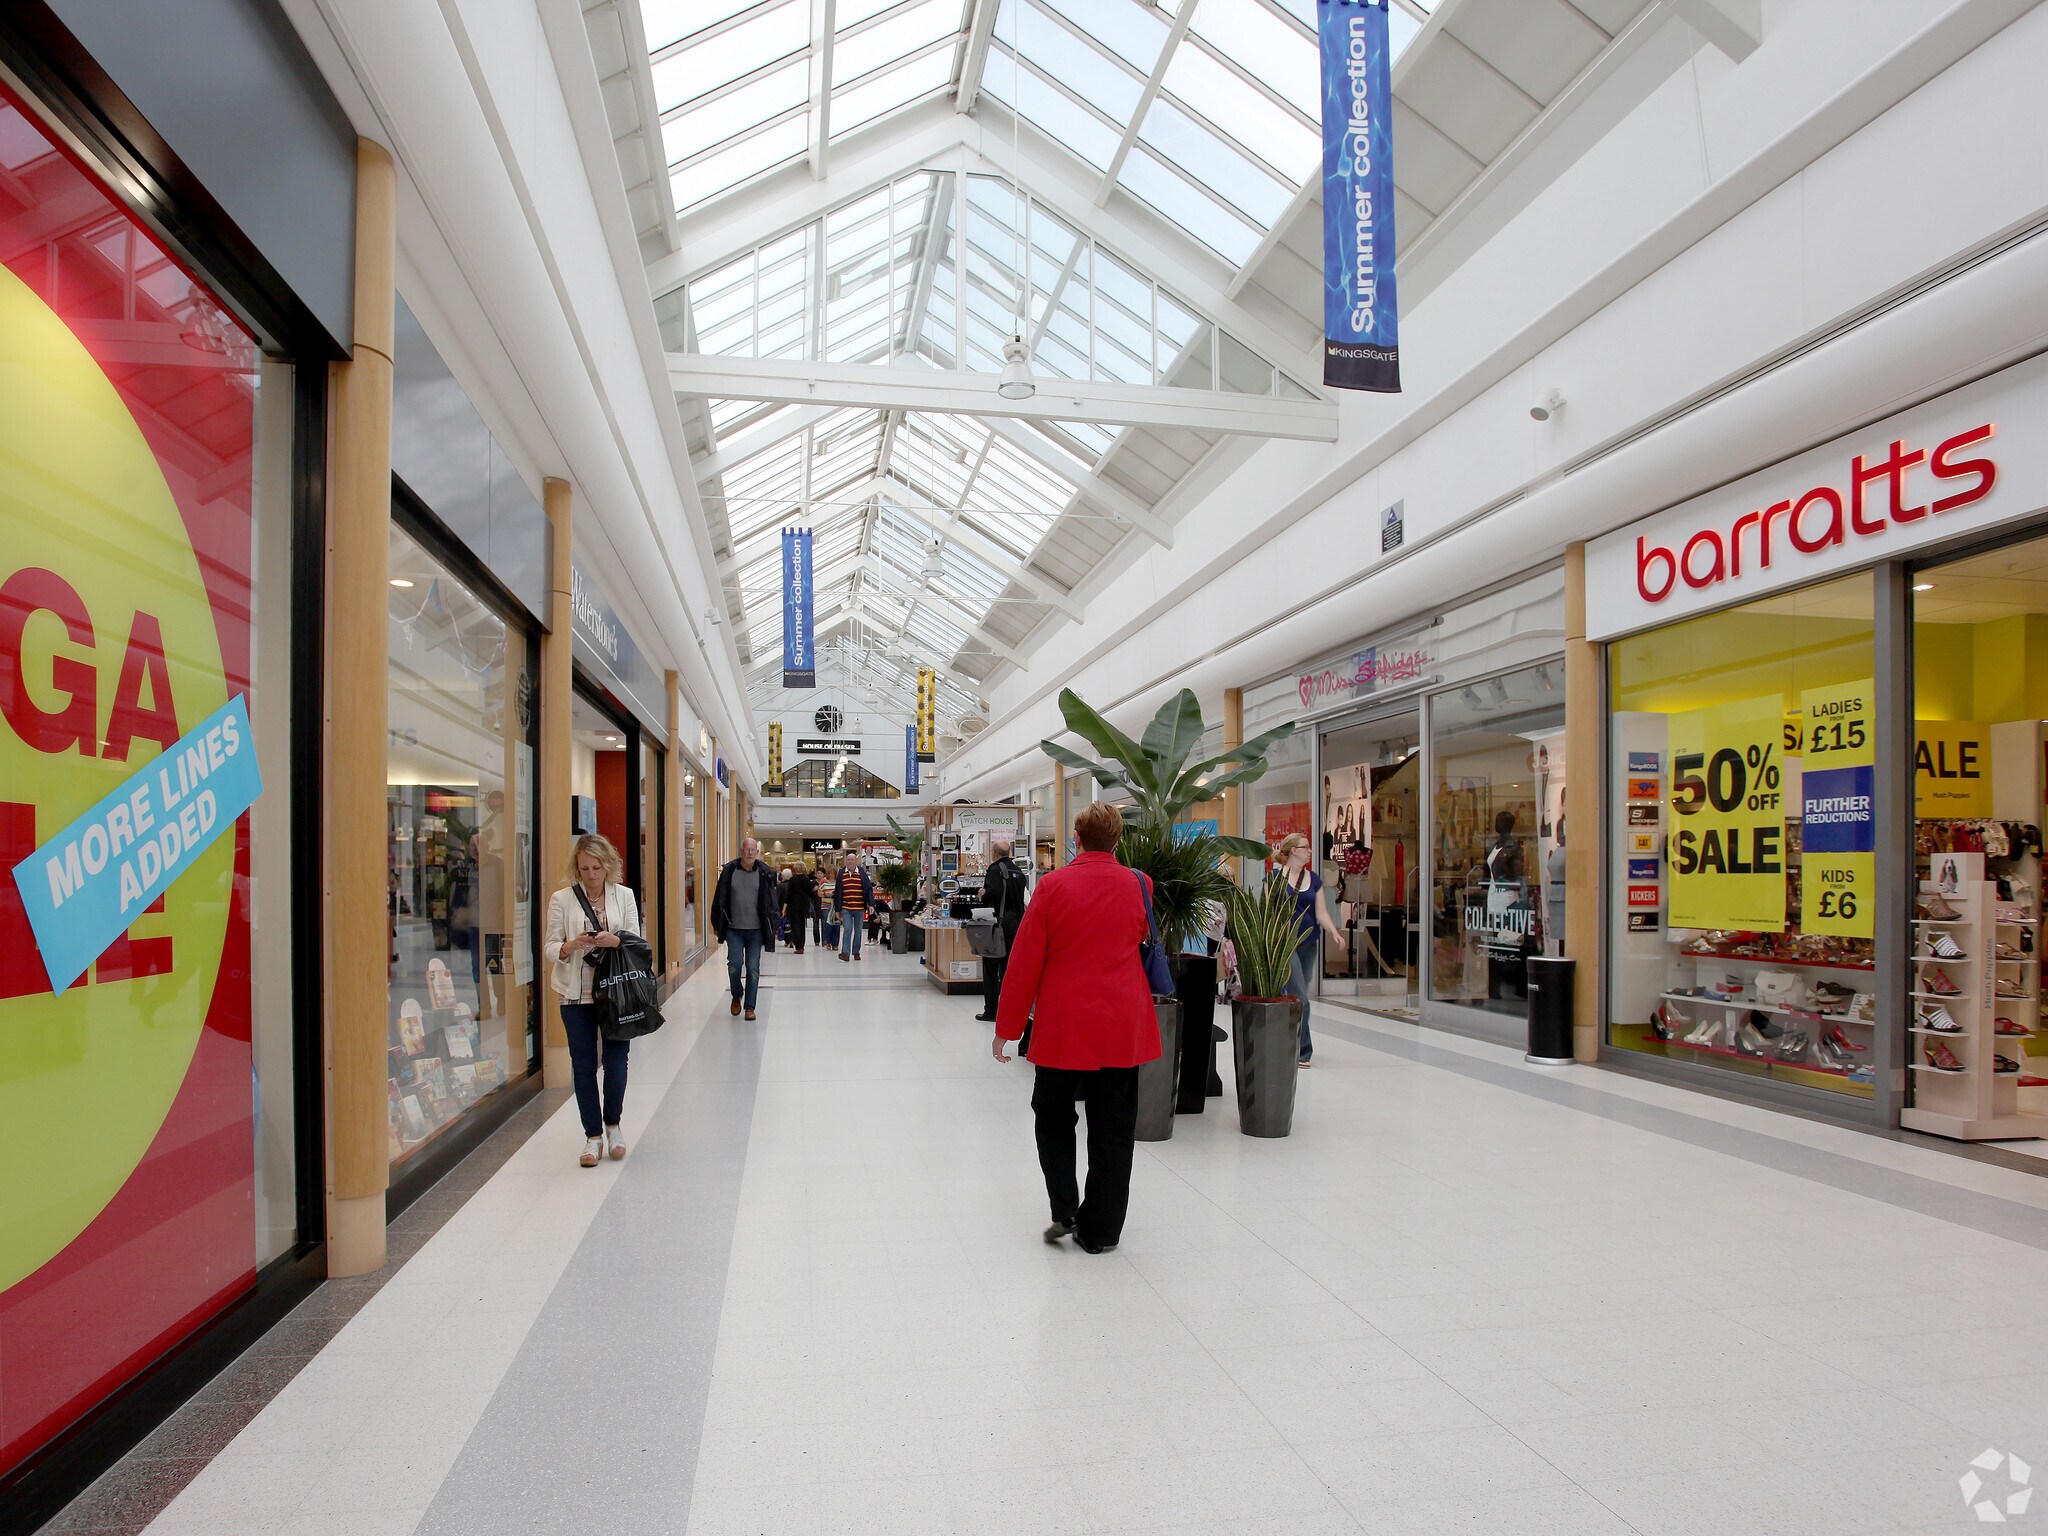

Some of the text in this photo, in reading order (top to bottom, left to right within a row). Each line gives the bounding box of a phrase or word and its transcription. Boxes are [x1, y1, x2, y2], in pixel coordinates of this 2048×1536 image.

[1346, 17, 1374, 334] Summer collection
[1334, 347, 1398, 362] KINGSGATE
[1636, 422, 1998, 603] barratts
[792, 539, 803, 666] Summer collection
[1355, 650, 1429, 685] Selfridge
[1813, 698, 1862, 718] LADIES
[1784, 724, 1803, 751] S
[1810, 719, 1866, 753] £15
[1671, 742, 1780, 816] 50%
[46, 714, 240, 909] MORE LINES
[1747, 793, 1780, 812] OFF
[1805, 796, 1870, 813] FURTHER
[1805, 810, 1870, 824] REDUCTIONS
[964, 817, 1014, 825] WATCH HOUSE
[119, 789, 217, 914] ADDED
[1671, 826, 1781, 875] SALE
[1821, 869, 1855, 883] KIDS
[1630, 890, 1656, 901] KICKERS
[1817, 890, 1857, 920] £6
[1464, 906, 1536, 936] COLLECTIVE
[599, 969, 648, 989] BURTON
